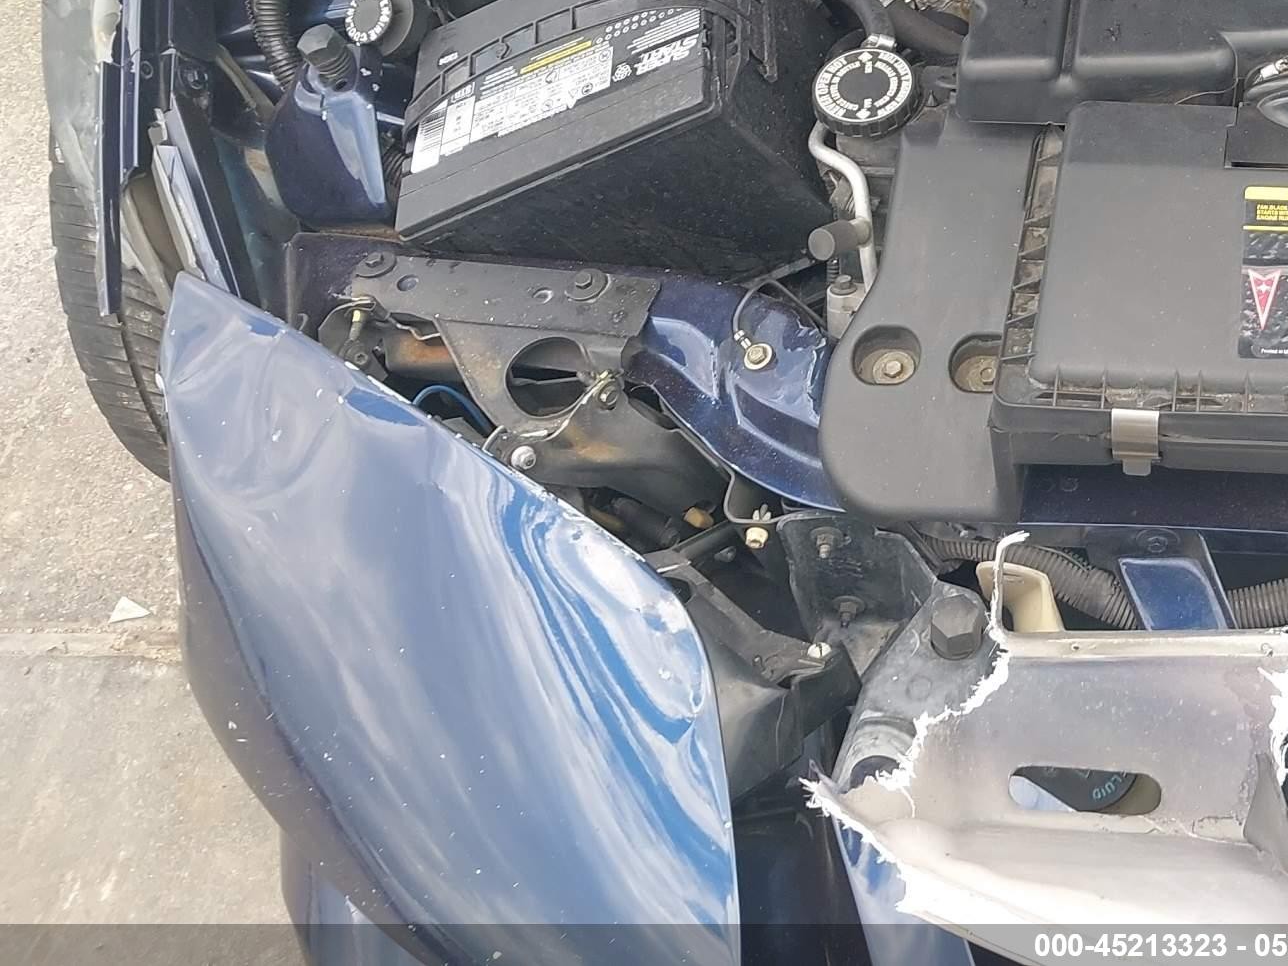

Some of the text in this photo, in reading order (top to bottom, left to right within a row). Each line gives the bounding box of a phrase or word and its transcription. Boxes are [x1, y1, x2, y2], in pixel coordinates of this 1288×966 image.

[639, 34, 700, 63] START
[633, 49, 690, 76] SUPER
[827, 56, 848, 75] HOT
